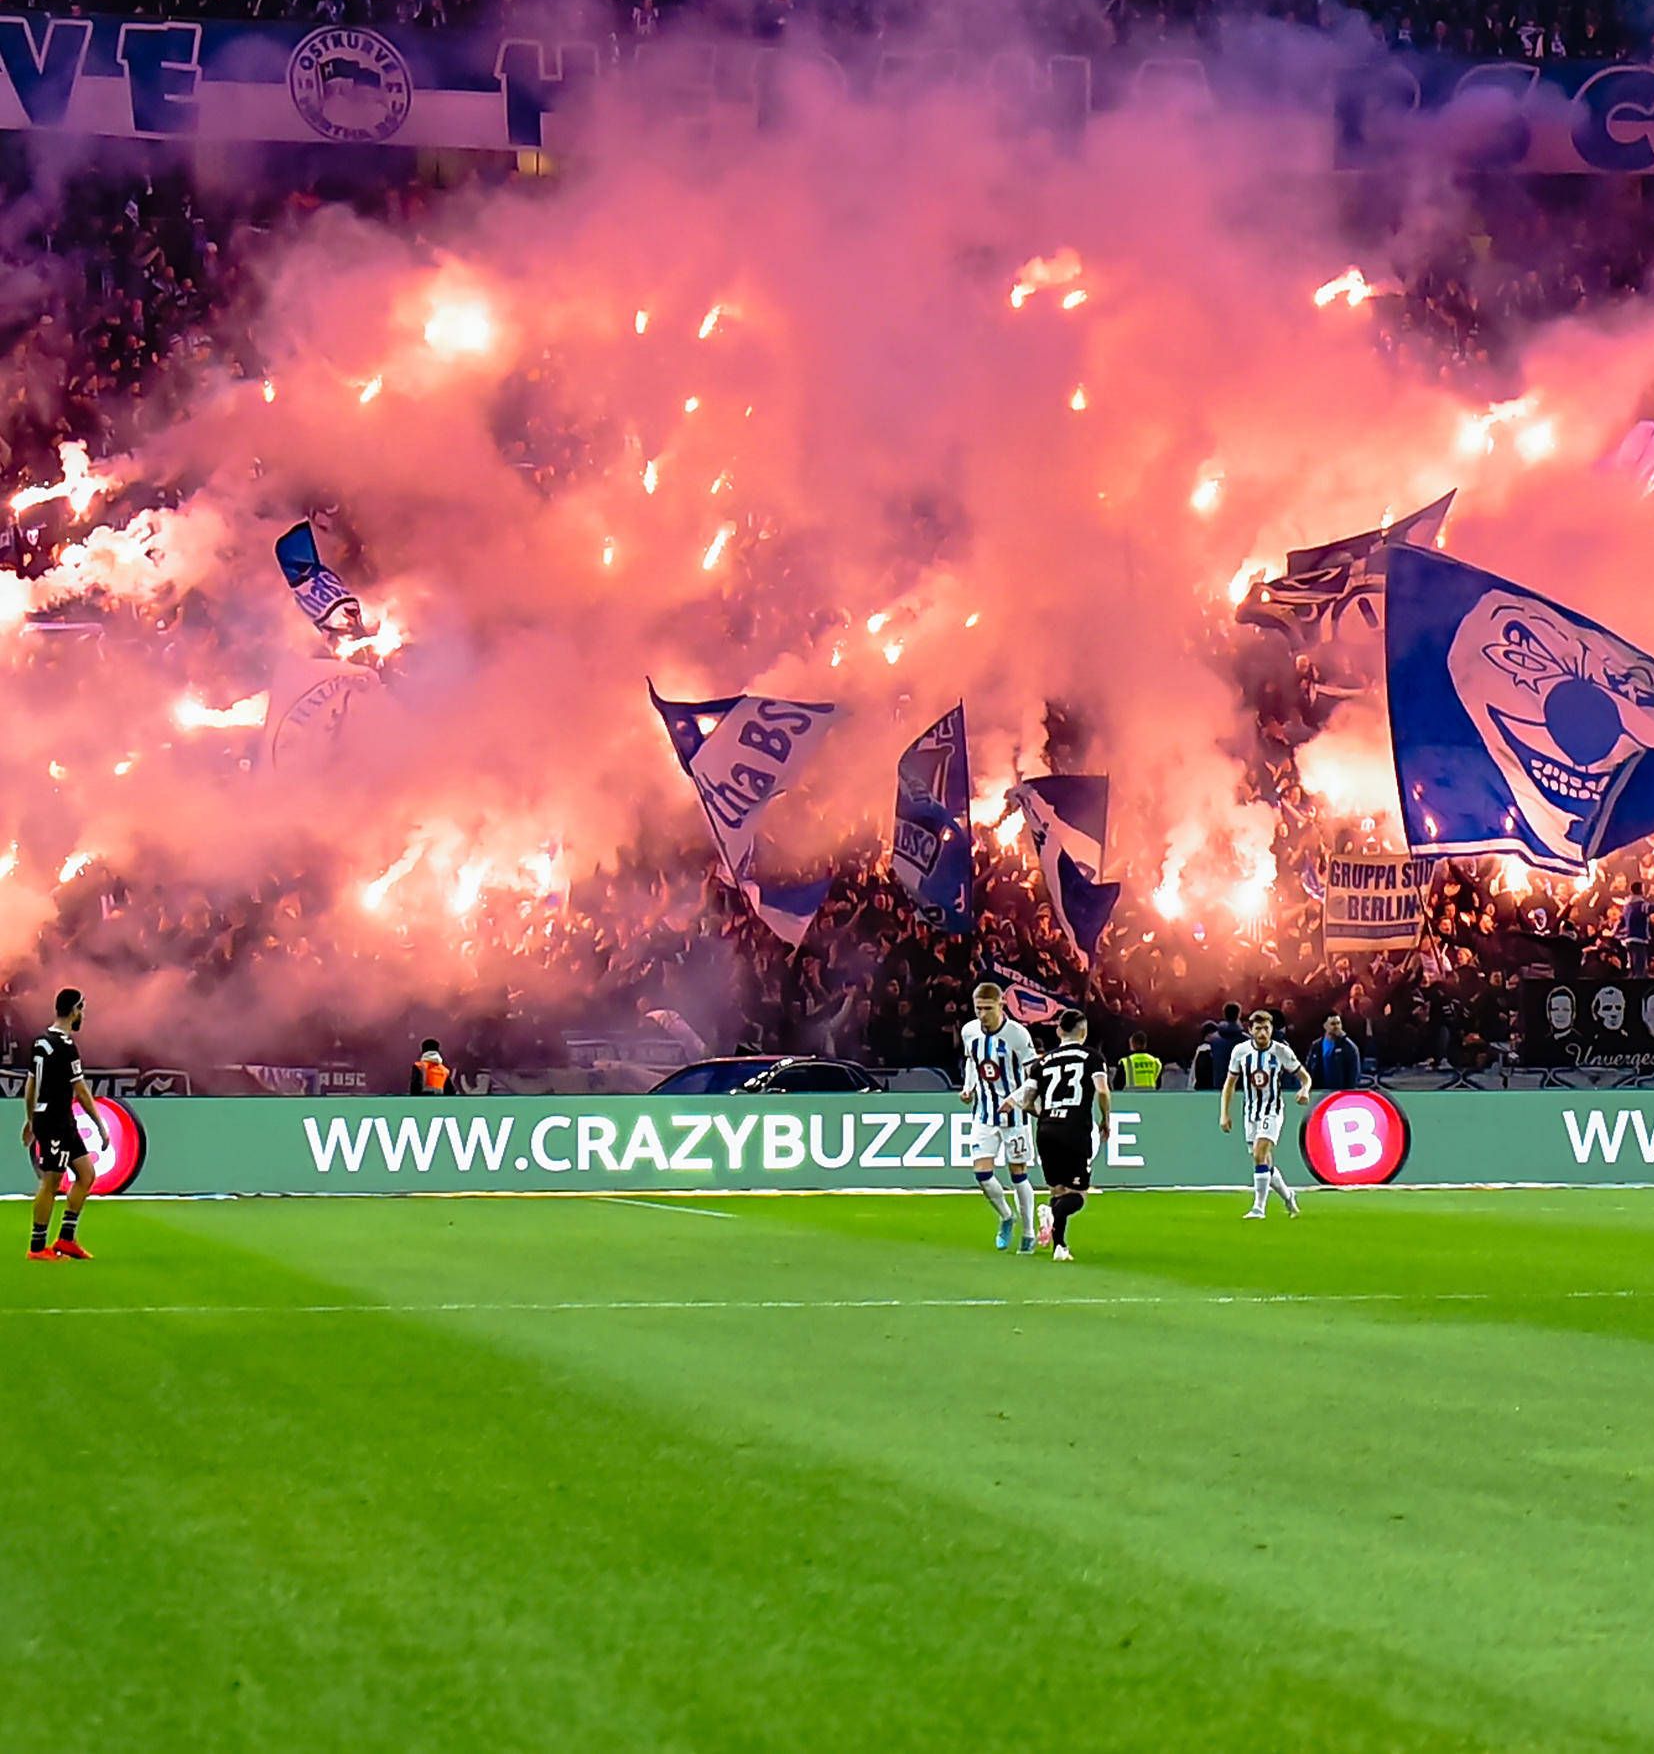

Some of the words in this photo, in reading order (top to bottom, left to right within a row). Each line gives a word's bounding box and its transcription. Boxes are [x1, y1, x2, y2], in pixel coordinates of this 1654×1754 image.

[1330, 859, 1397, 891] GRUPPA
[1347, 894, 1418, 922] BERLIN
[303, 1112, 1146, 1172] WWW.CRAZYBUZZEE
[1326, 1106, 1383, 1175] B
